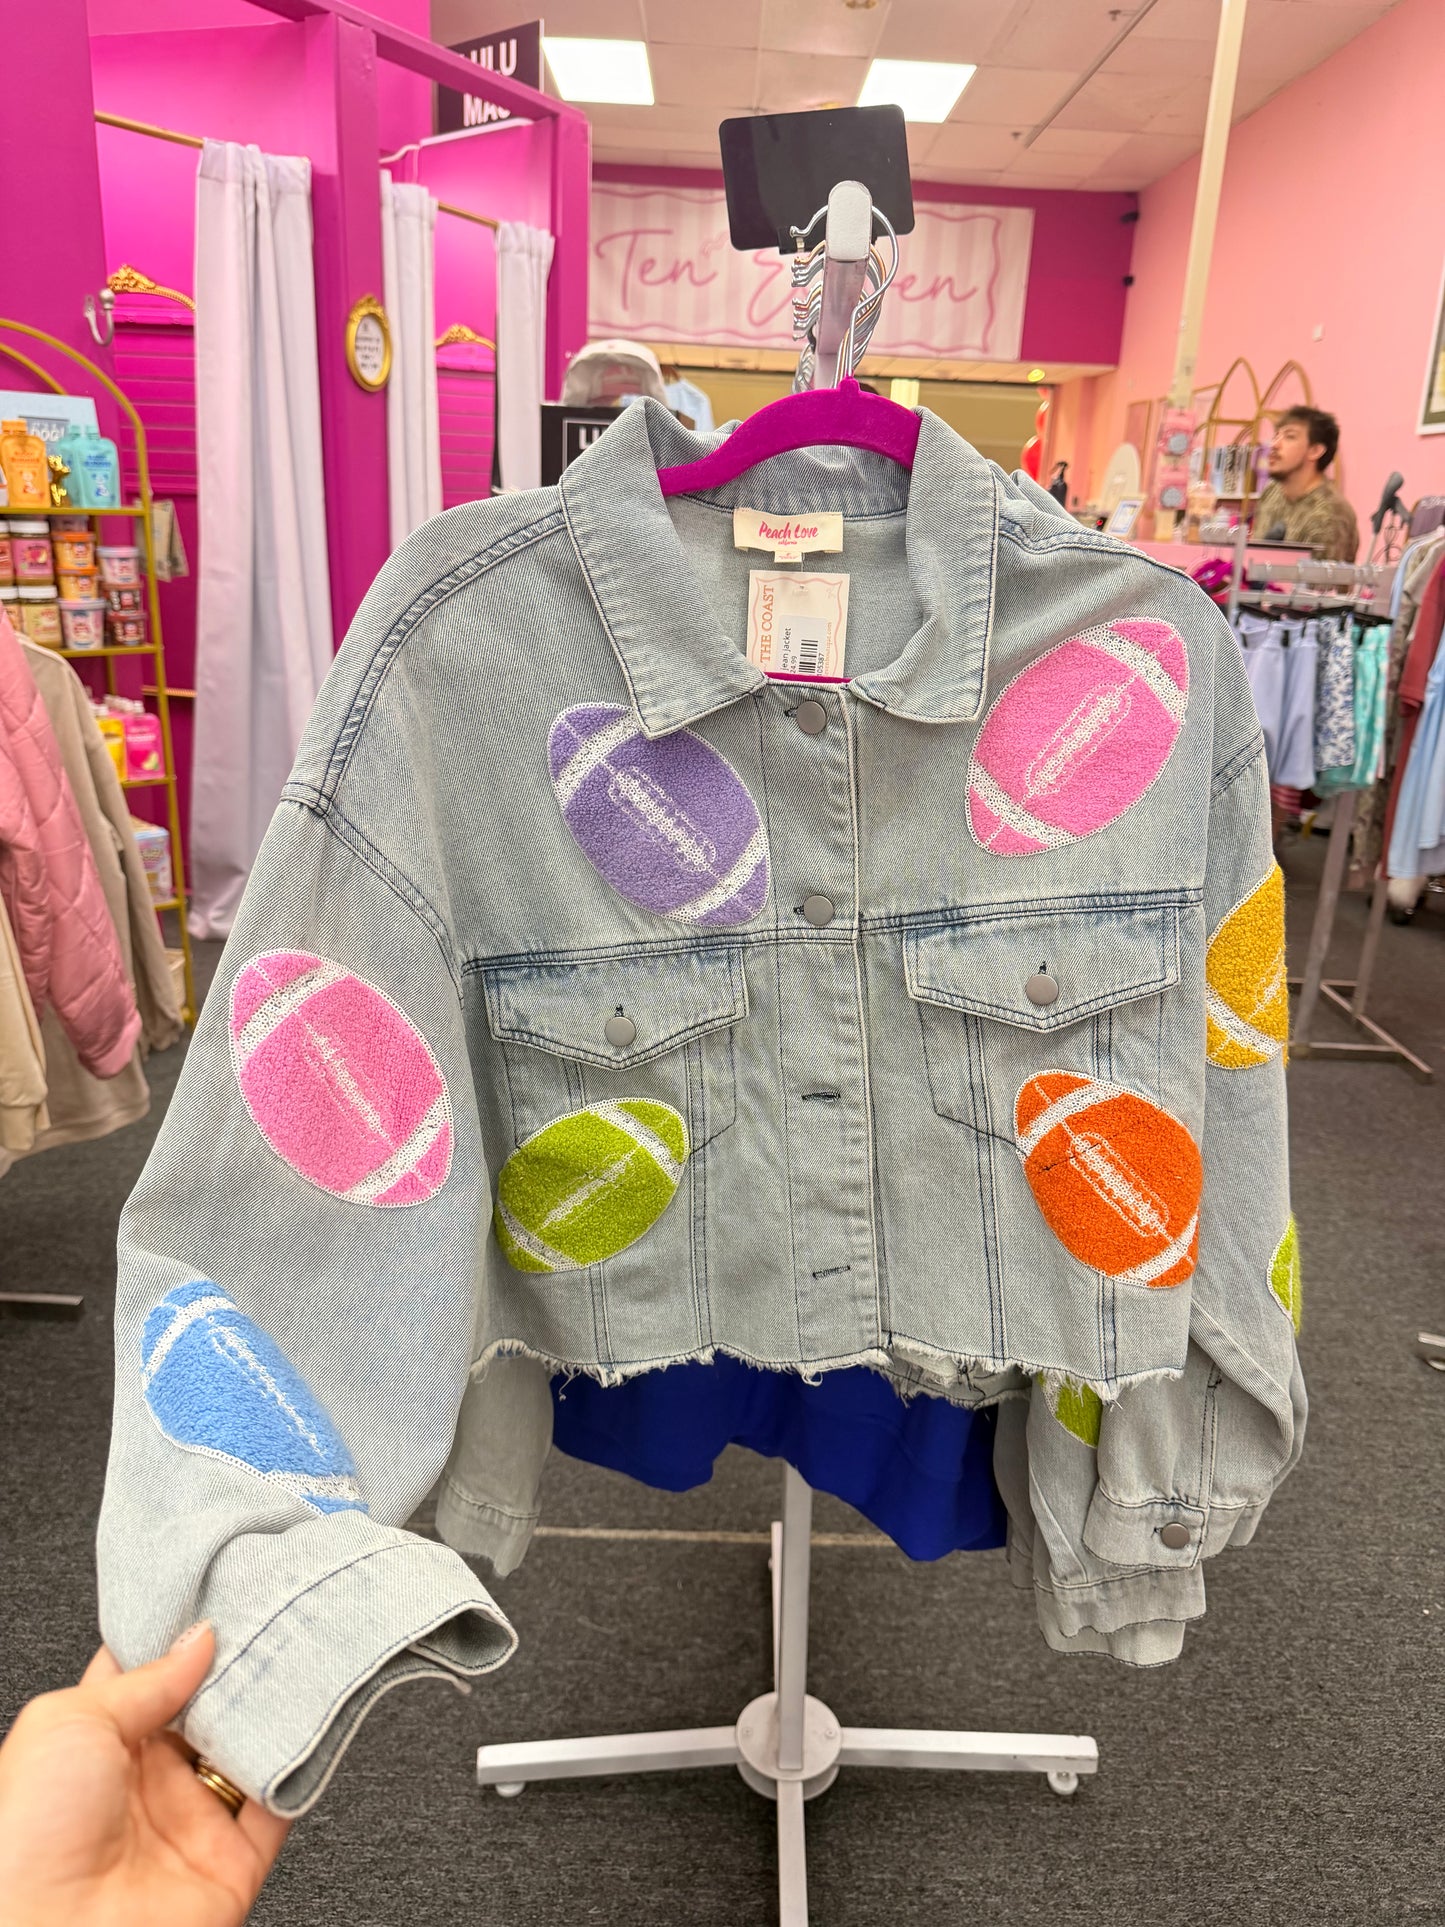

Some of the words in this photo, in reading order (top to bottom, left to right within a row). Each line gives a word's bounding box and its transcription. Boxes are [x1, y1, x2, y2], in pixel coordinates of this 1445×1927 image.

[459, 38, 517, 76] LU
[594, 228, 719, 311] Ten
[747, 249, 978, 327] Een
[758, 520, 791, 539] Peach
[794, 523, 819, 539] Love
[761, 585, 774, 632] COAST
[760, 634, 772, 664] THE
[789, 655, 798, 674] 24.99
